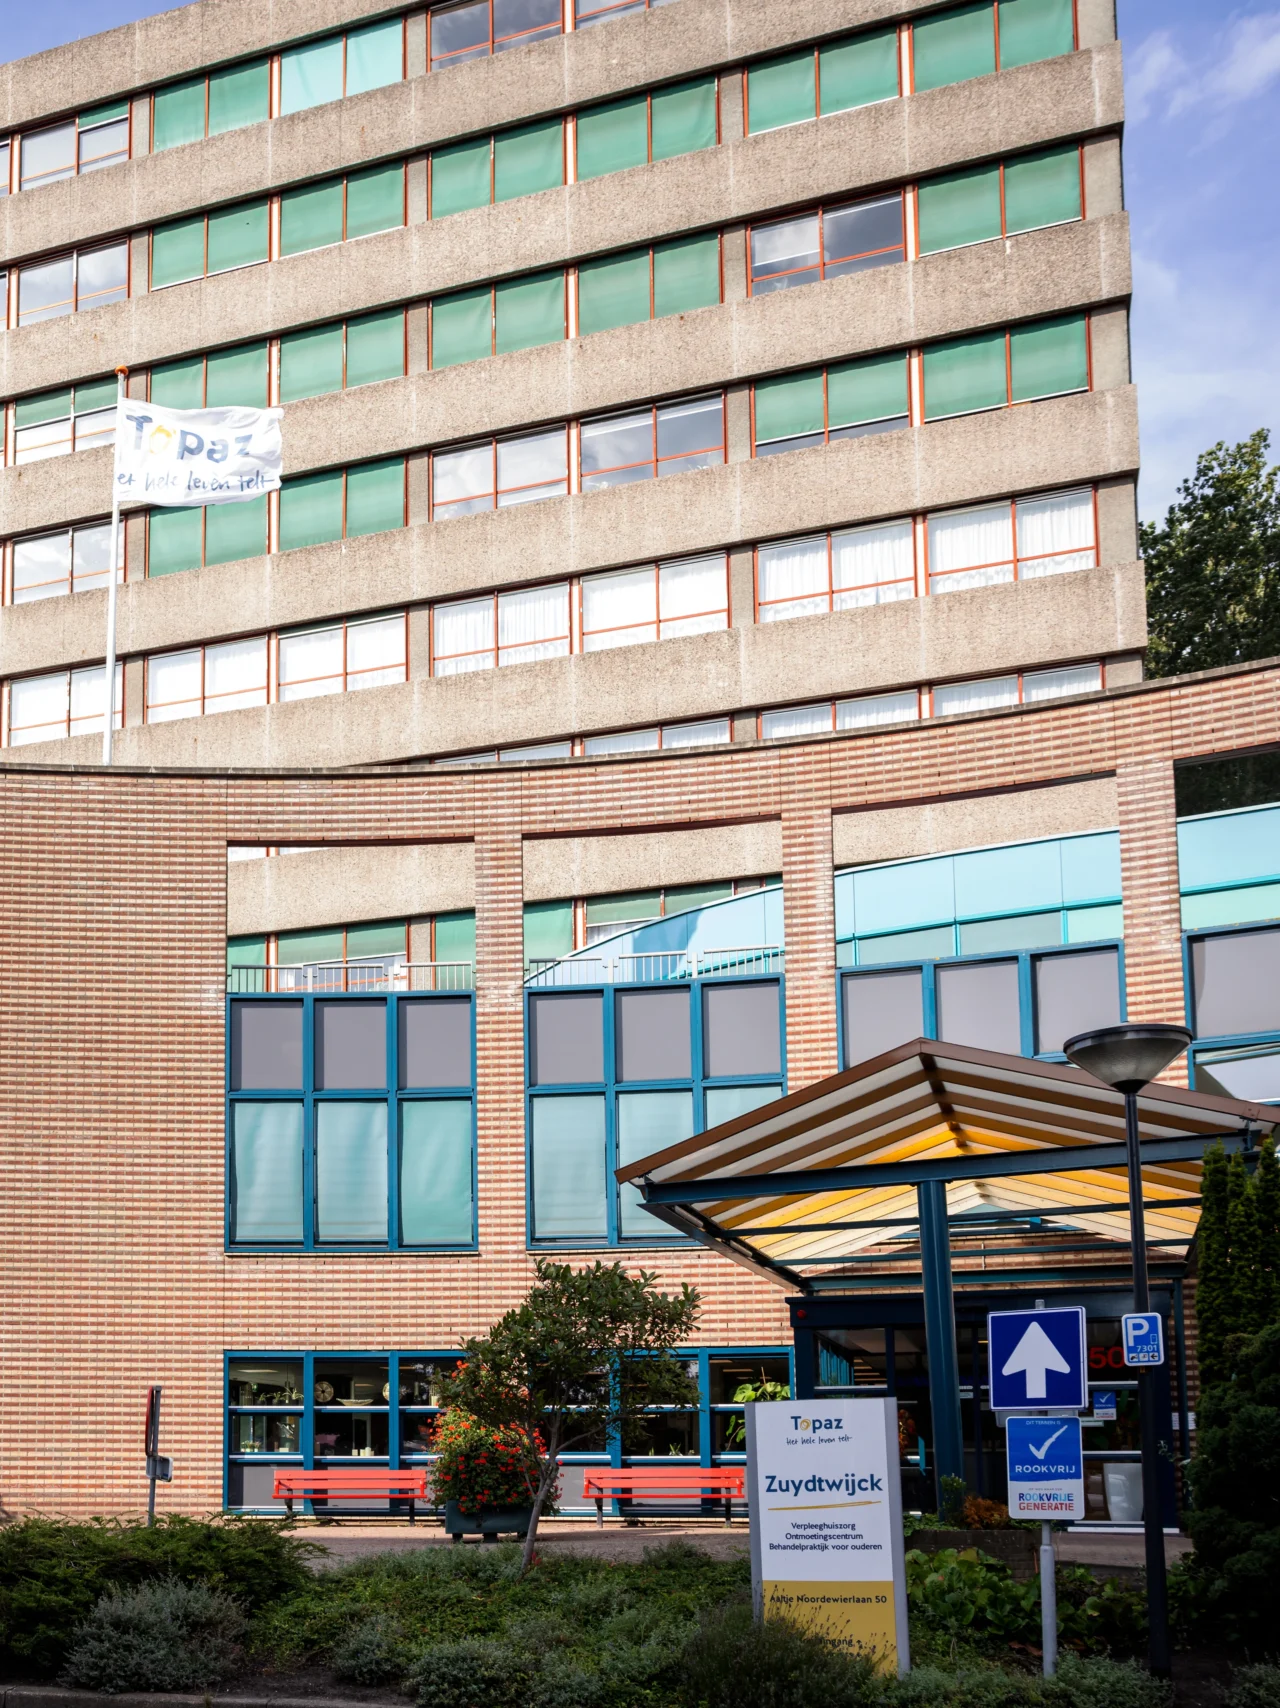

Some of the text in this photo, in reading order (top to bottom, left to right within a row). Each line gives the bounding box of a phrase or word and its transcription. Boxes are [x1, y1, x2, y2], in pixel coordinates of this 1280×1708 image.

[126, 414, 253, 464] Topaz
[1126, 1318, 1150, 1347] P
[1088, 1346, 1125, 1369] 50
[790, 1415, 843, 1433] Topaz
[786, 1434, 853, 1446] Het hele leven telt
[1015, 1465, 1075, 1473] ROOKVRIJ
[765, 1473, 883, 1497] Zuydtwijck
[1019, 1493, 1074, 1501] ROOKVRIJE
[1019, 1502, 1074, 1511] GENERATIE
[791, 1522, 856, 1531] Verpleeghuiszorg
[785, 1533, 864, 1541] Ontmoetingscentrum
[769, 1543, 829, 1552] Behandelpraktijk
[797, 1595, 872, 1603] Noordewierlaan
